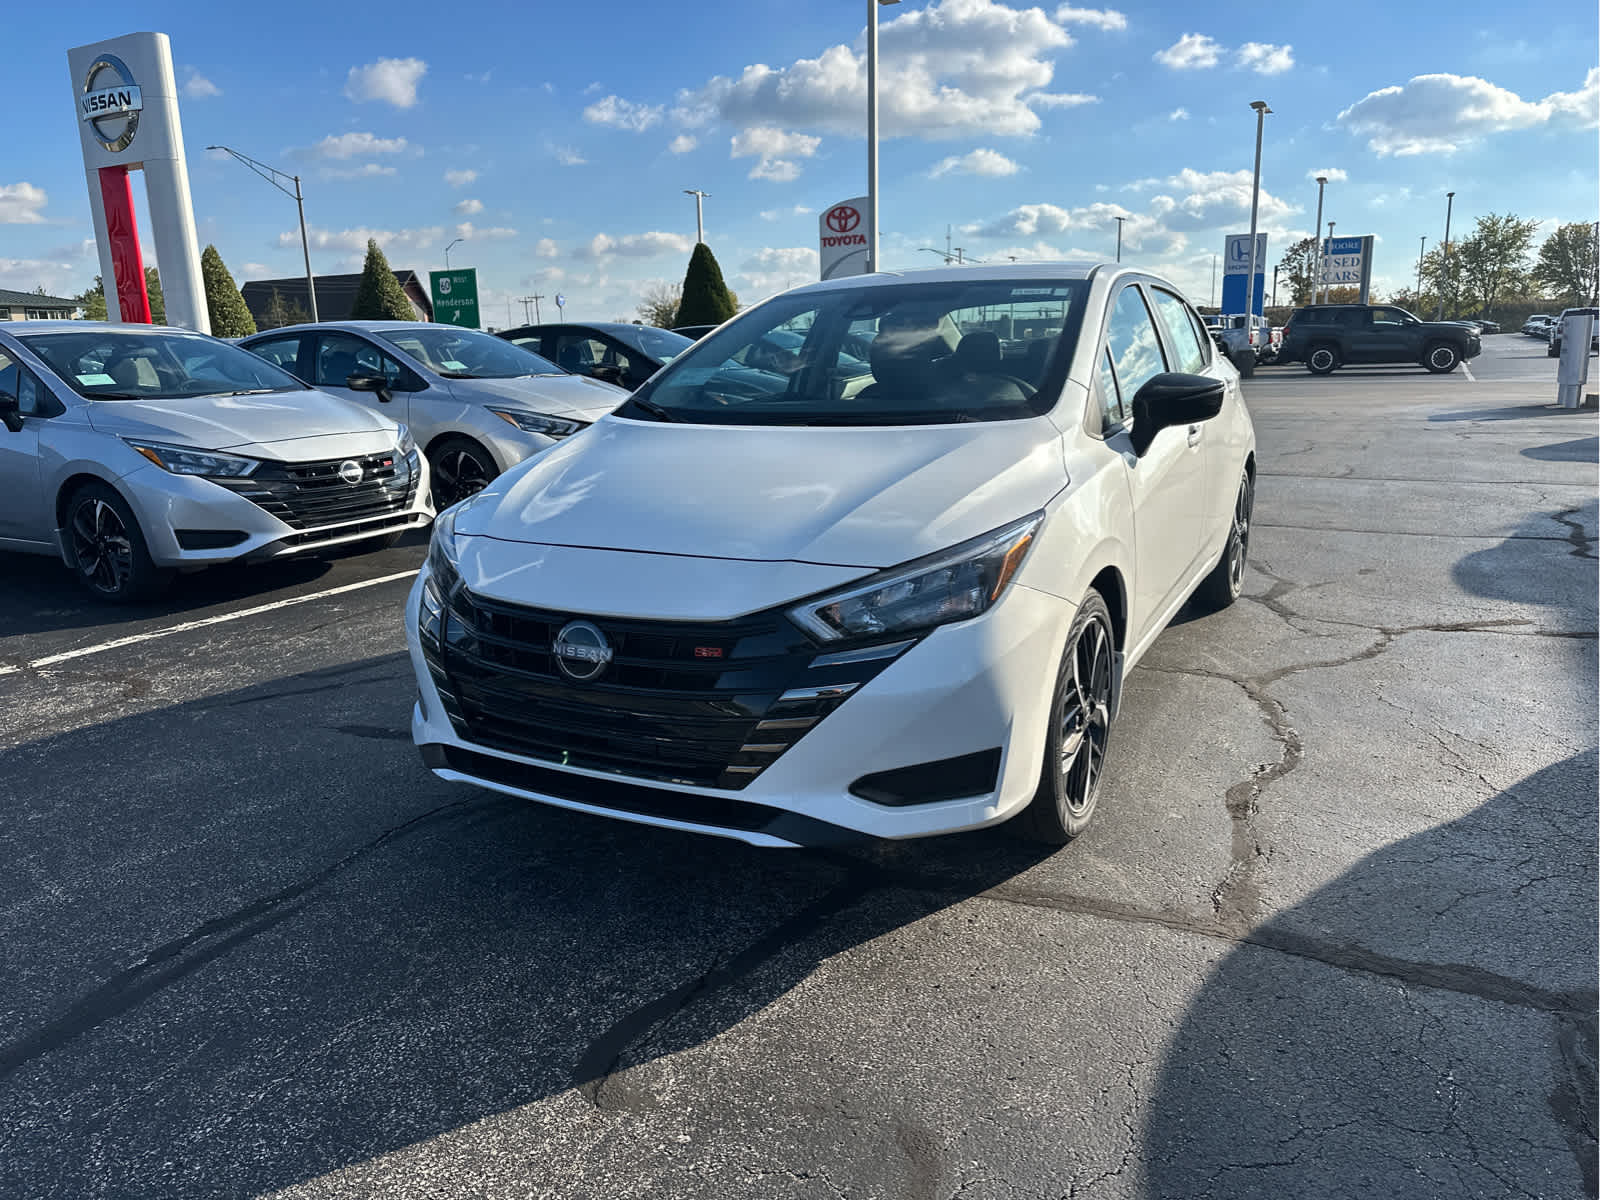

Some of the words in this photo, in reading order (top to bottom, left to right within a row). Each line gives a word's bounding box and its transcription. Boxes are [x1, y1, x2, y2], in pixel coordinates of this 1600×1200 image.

[83, 91, 131, 113] NISSAN
[821, 234, 866, 248] TOYOTA
[1322, 271, 1360, 281] CARS
[440, 280, 450, 291] 60
[437, 298, 474, 306] Henderson
[553, 641, 612, 662] NISSAN
